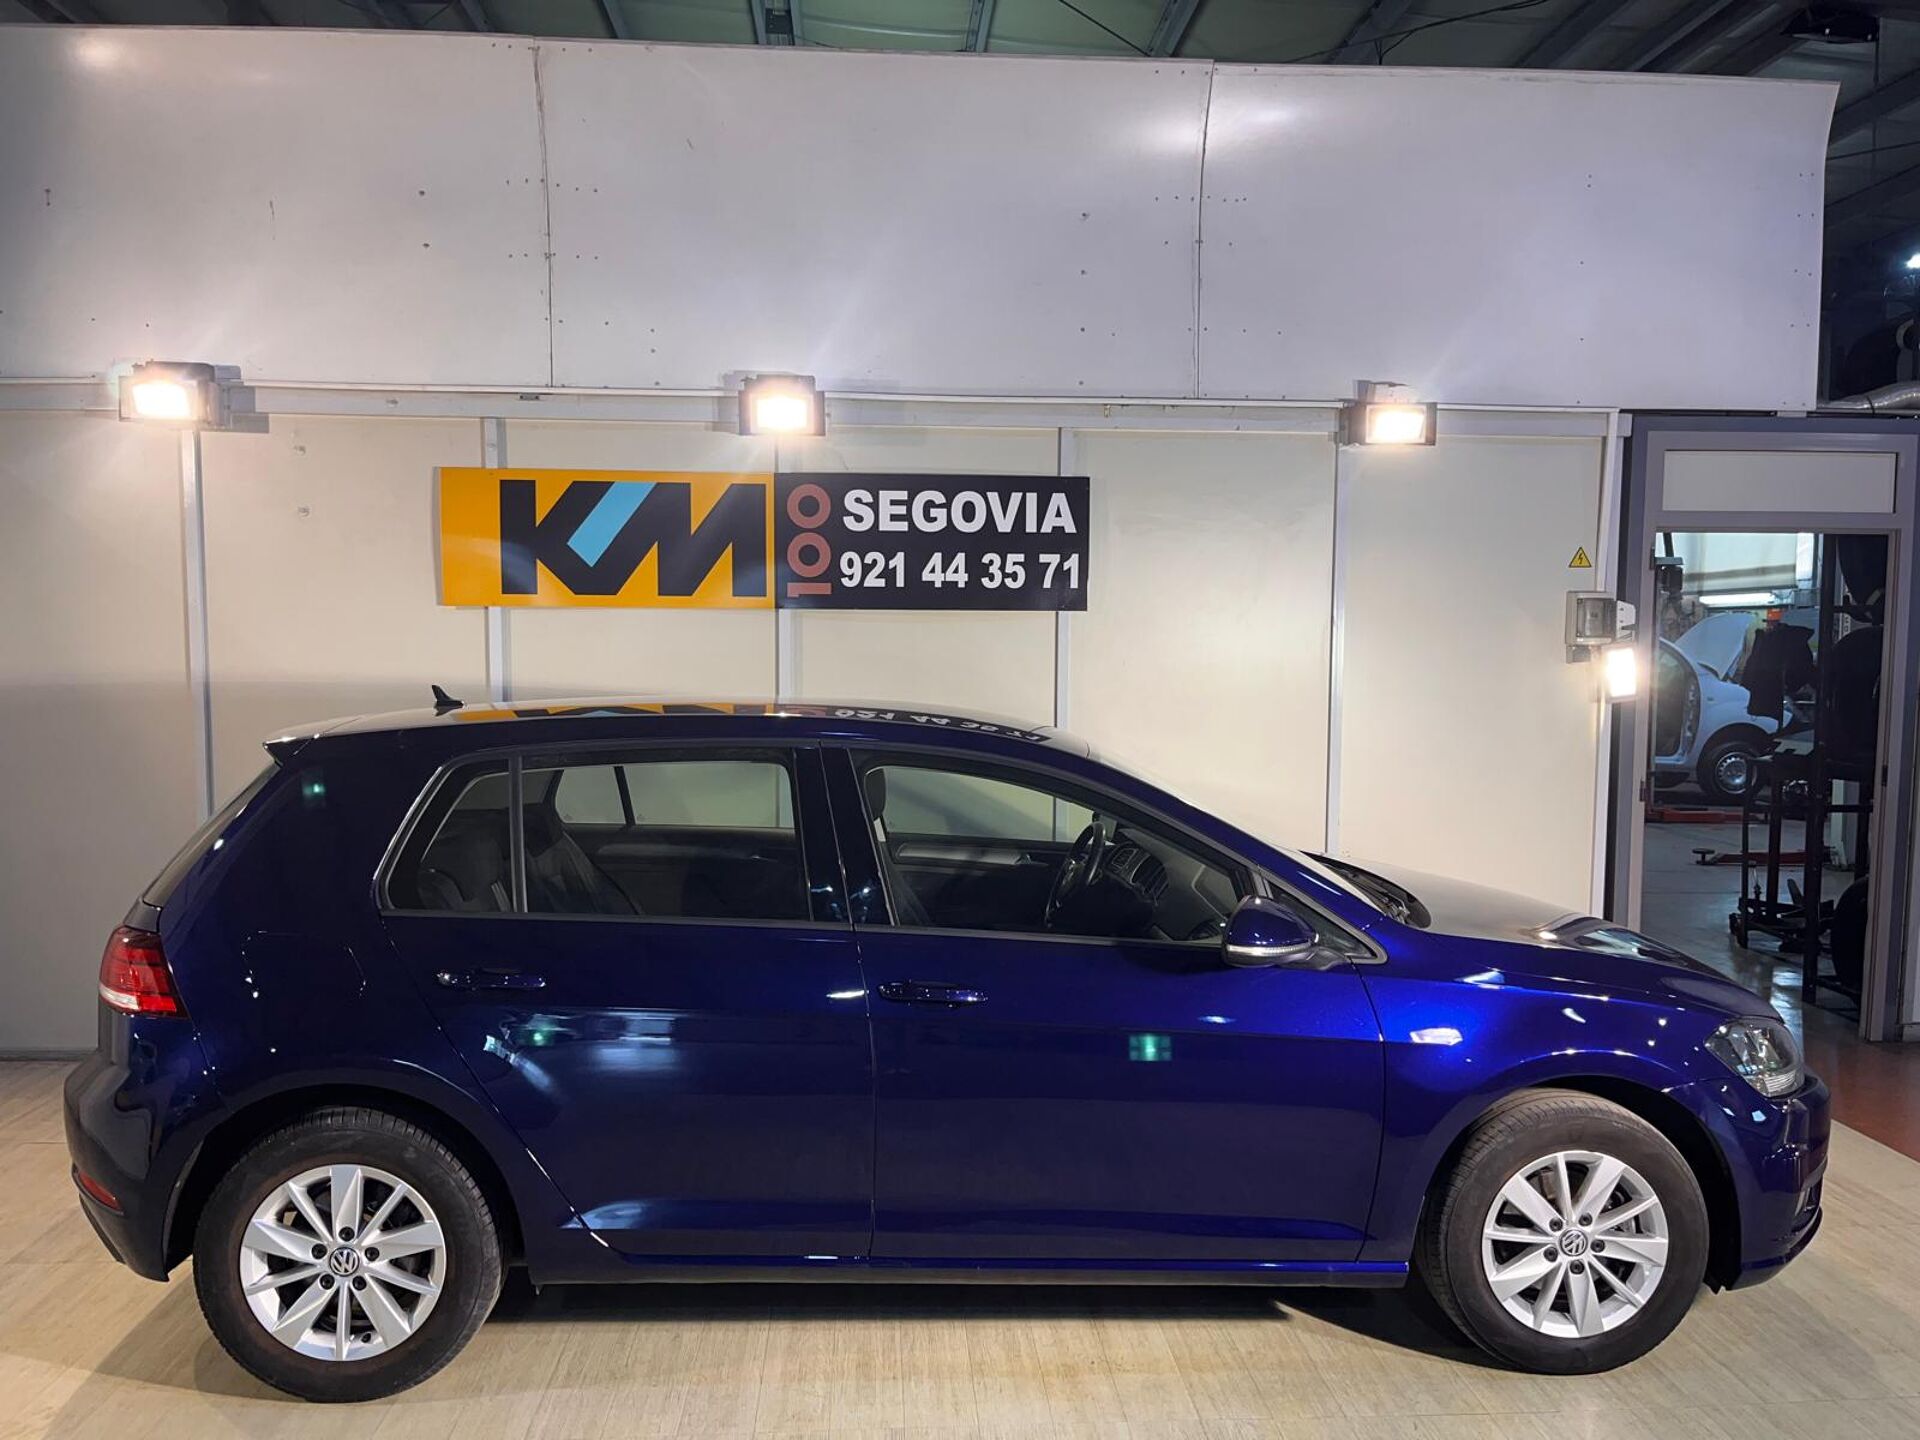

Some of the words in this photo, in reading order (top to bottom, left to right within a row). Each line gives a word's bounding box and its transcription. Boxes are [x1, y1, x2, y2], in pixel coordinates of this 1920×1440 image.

[500, 479, 767, 597] KM
[786, 483, 832, 598] 100
[843, 488, 1077, 534] SEGOVIA
[839, 551, 906, 588] 921
[921, 552, 969, 588] 44
[980, 553, 1026, 589] 35
[1038, 553, 1080, 589] 71
